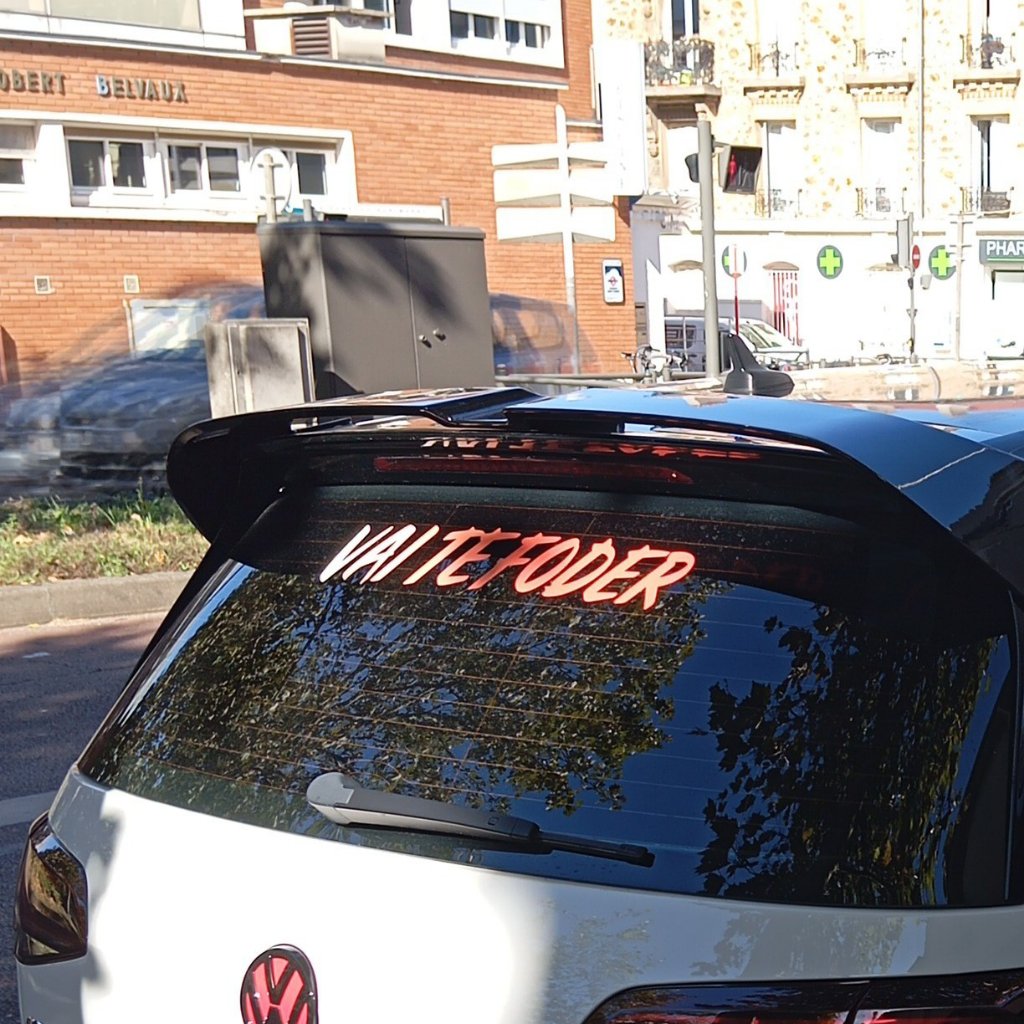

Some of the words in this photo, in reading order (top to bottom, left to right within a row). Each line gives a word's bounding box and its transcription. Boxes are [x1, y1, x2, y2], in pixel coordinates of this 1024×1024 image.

[0, 69, 67, 96] OBERT
[96, 74, 189, 103] BELVAUX
[319, 523, 441, 585] VAI
[467, 532, 697, 612] FODER
